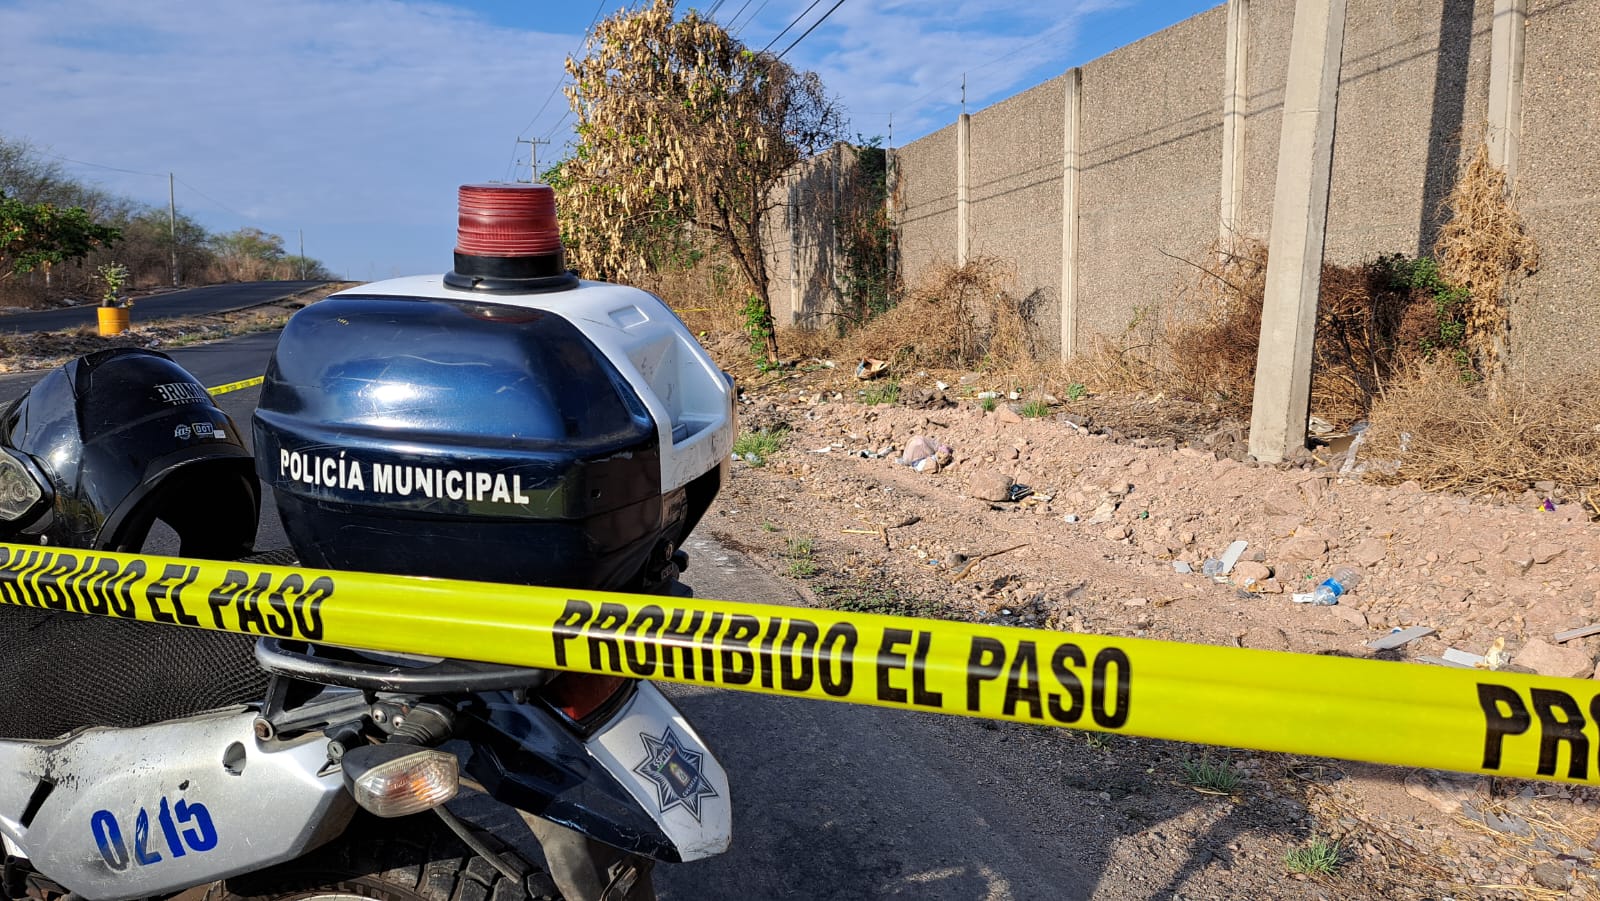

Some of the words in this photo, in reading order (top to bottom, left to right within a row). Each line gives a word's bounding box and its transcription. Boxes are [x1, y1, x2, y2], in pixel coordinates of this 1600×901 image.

[195, 425, 211, 433] DOT
[280, 448, 365, 491] POLICÍA
[373, 463, 529, 504] MUNICIPAL
[146, 564, 201, 625] EL
[208, 570, 335, 640] PASO
[553, 599, 858, 698] PROHIBIDO
[876, 628, 943, 708] EL
[967, 636, 1132, 729] PASO
[1476, 682, 1600, 780] PR
